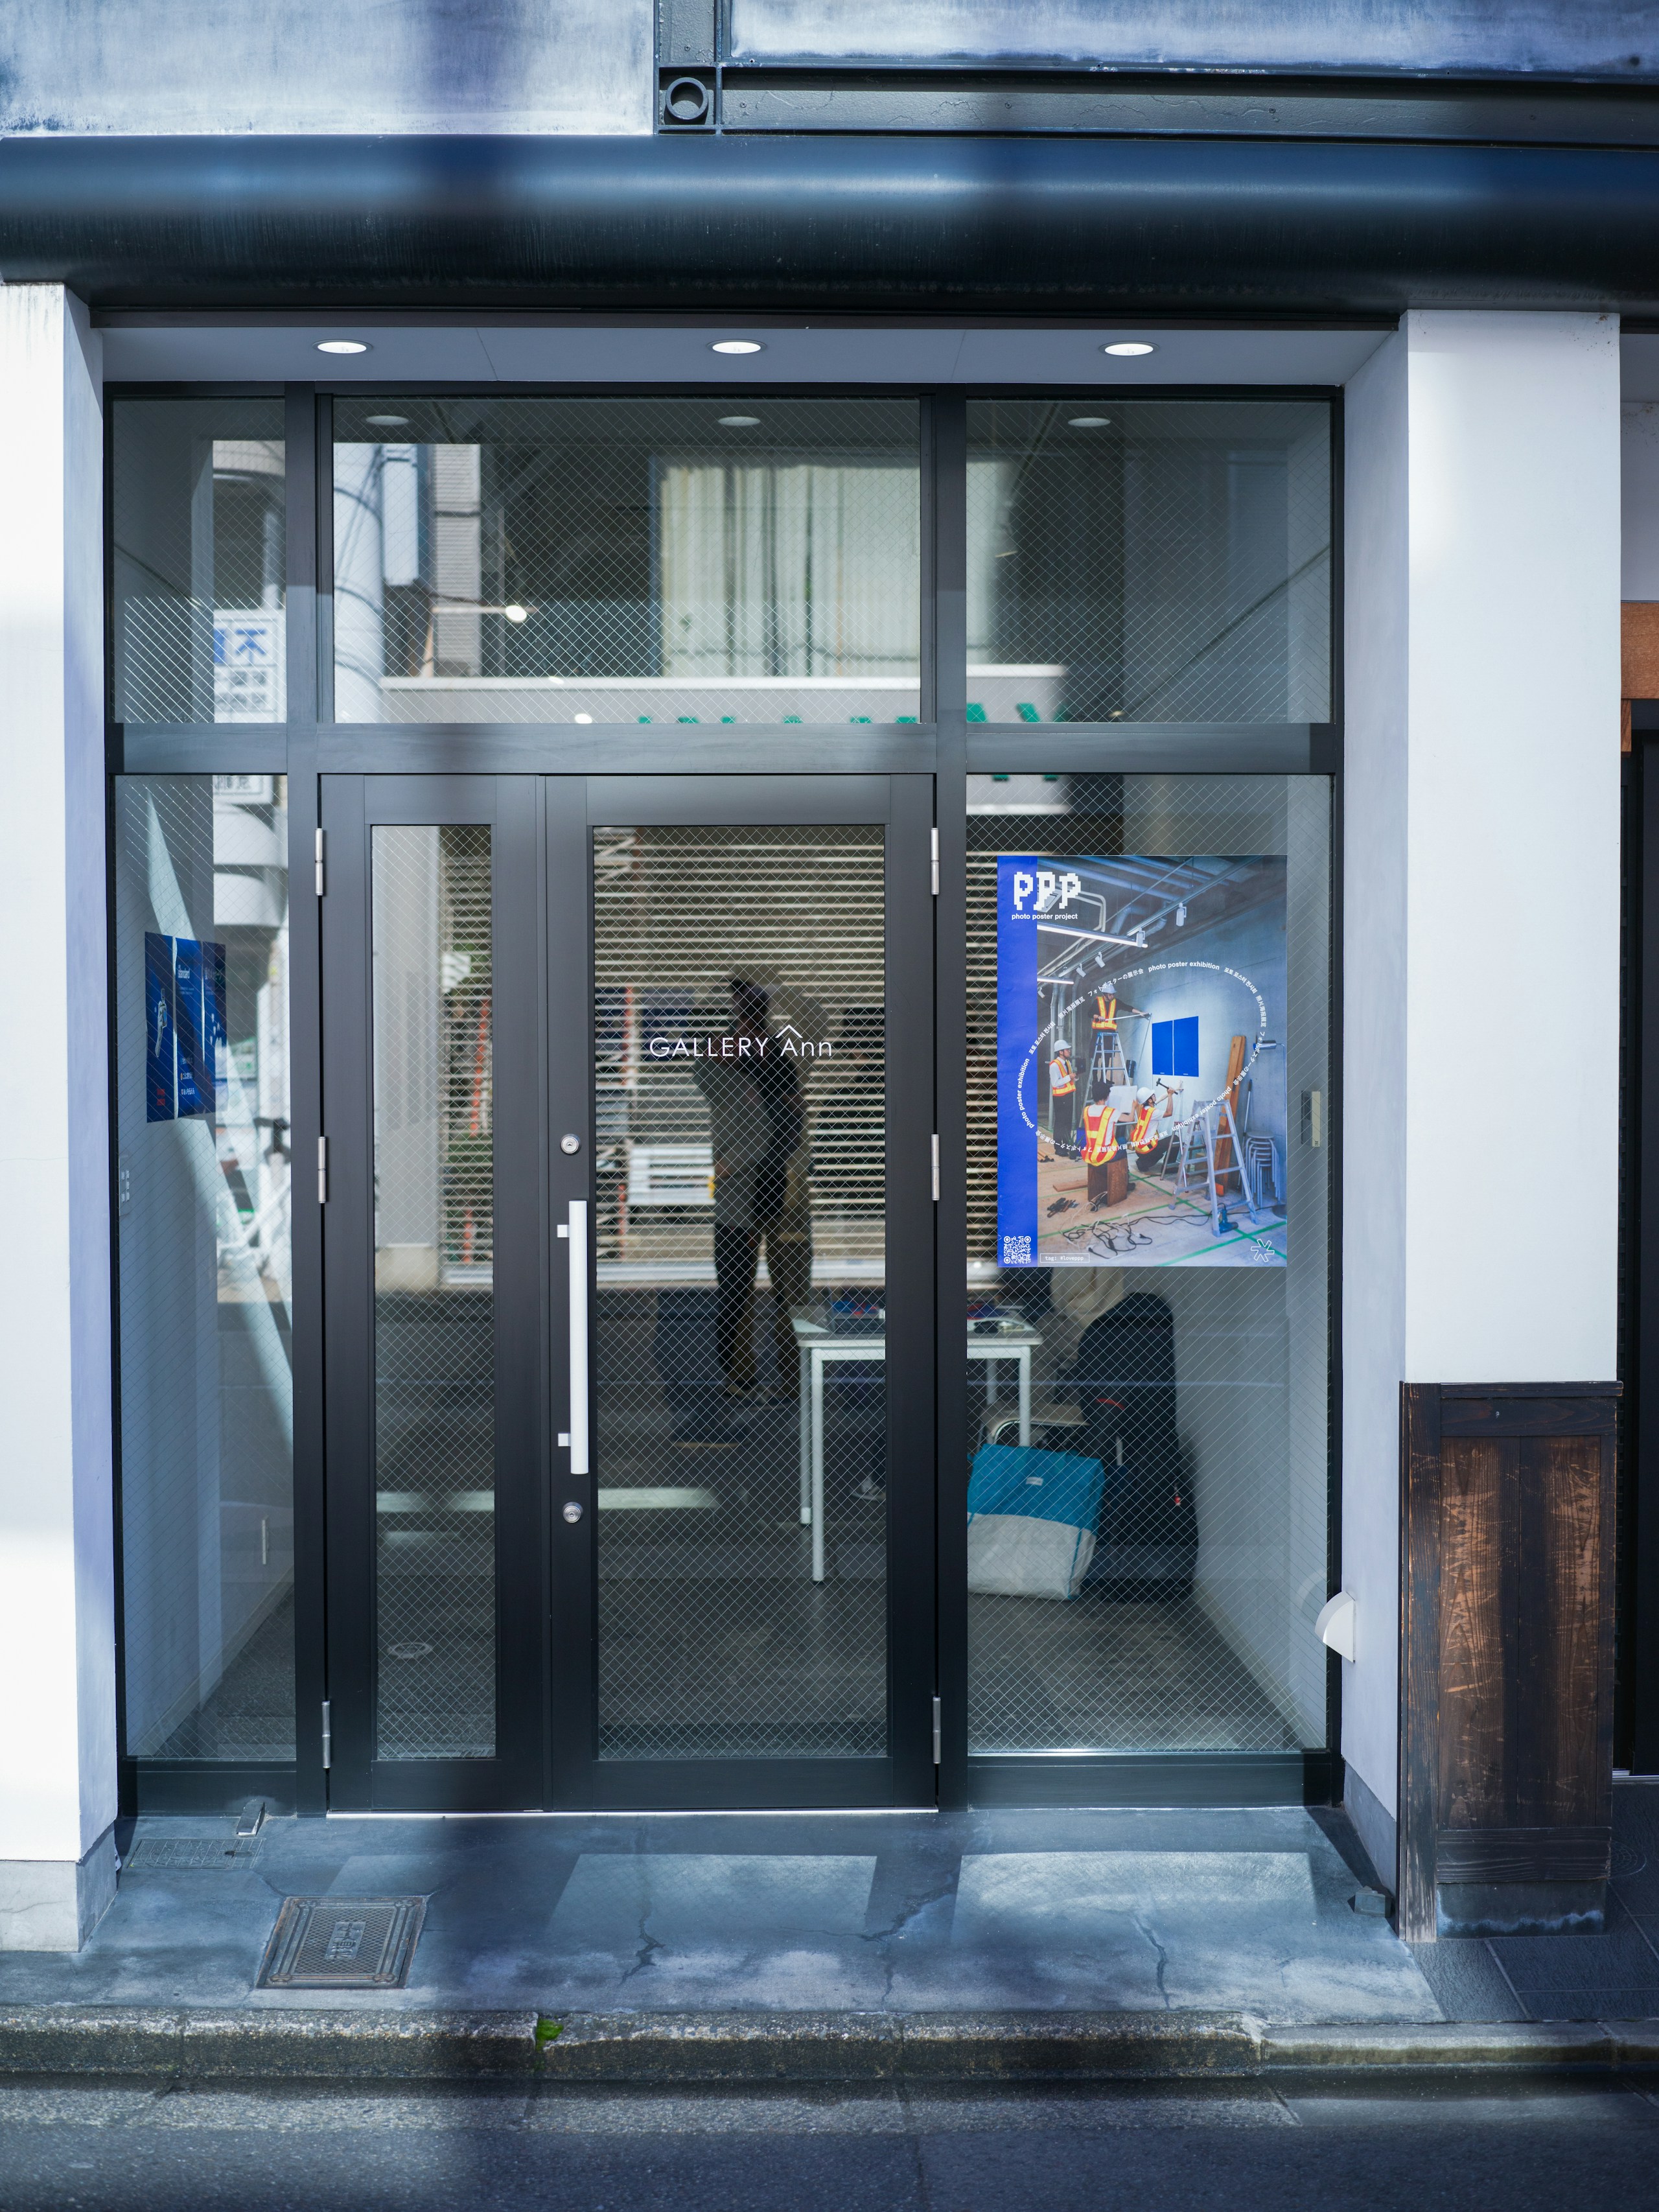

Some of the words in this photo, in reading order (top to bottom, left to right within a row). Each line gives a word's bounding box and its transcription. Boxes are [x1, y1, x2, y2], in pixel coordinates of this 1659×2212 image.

[1148, 962, 1166, 973] photo
[1189, 961, 1220, 971] exhibition
[1087, 968, 1144, 997] フォトポスターの展示会
[1224, 967, 1233, 975] 포토
[1233, 972, 1247, 983] 포스터
[1246, 980, 1258, 994] 전시회
[649, 1037, 769, 1058] GALLERY
[1028, 1045, 1037, 1055] 포토
[1036, 1033, 1046, 1045] 포스터
[1043, 1021, 1056, 1034] 전시회
[1233, 1031, 1266, 1086] フォトポスターの展示会
[1017, 1058, 1030, 1089] exhibition
[1216, 1086, 1232, 1102] photo
[1200, 1100, 1217, 1115] poster
[1021, 1112, 1035, 1129] photo
[1172, 1114, 1199, 1132] exhibition
[1035, 1130, 1093, 1152] フォトポスターの展示会
